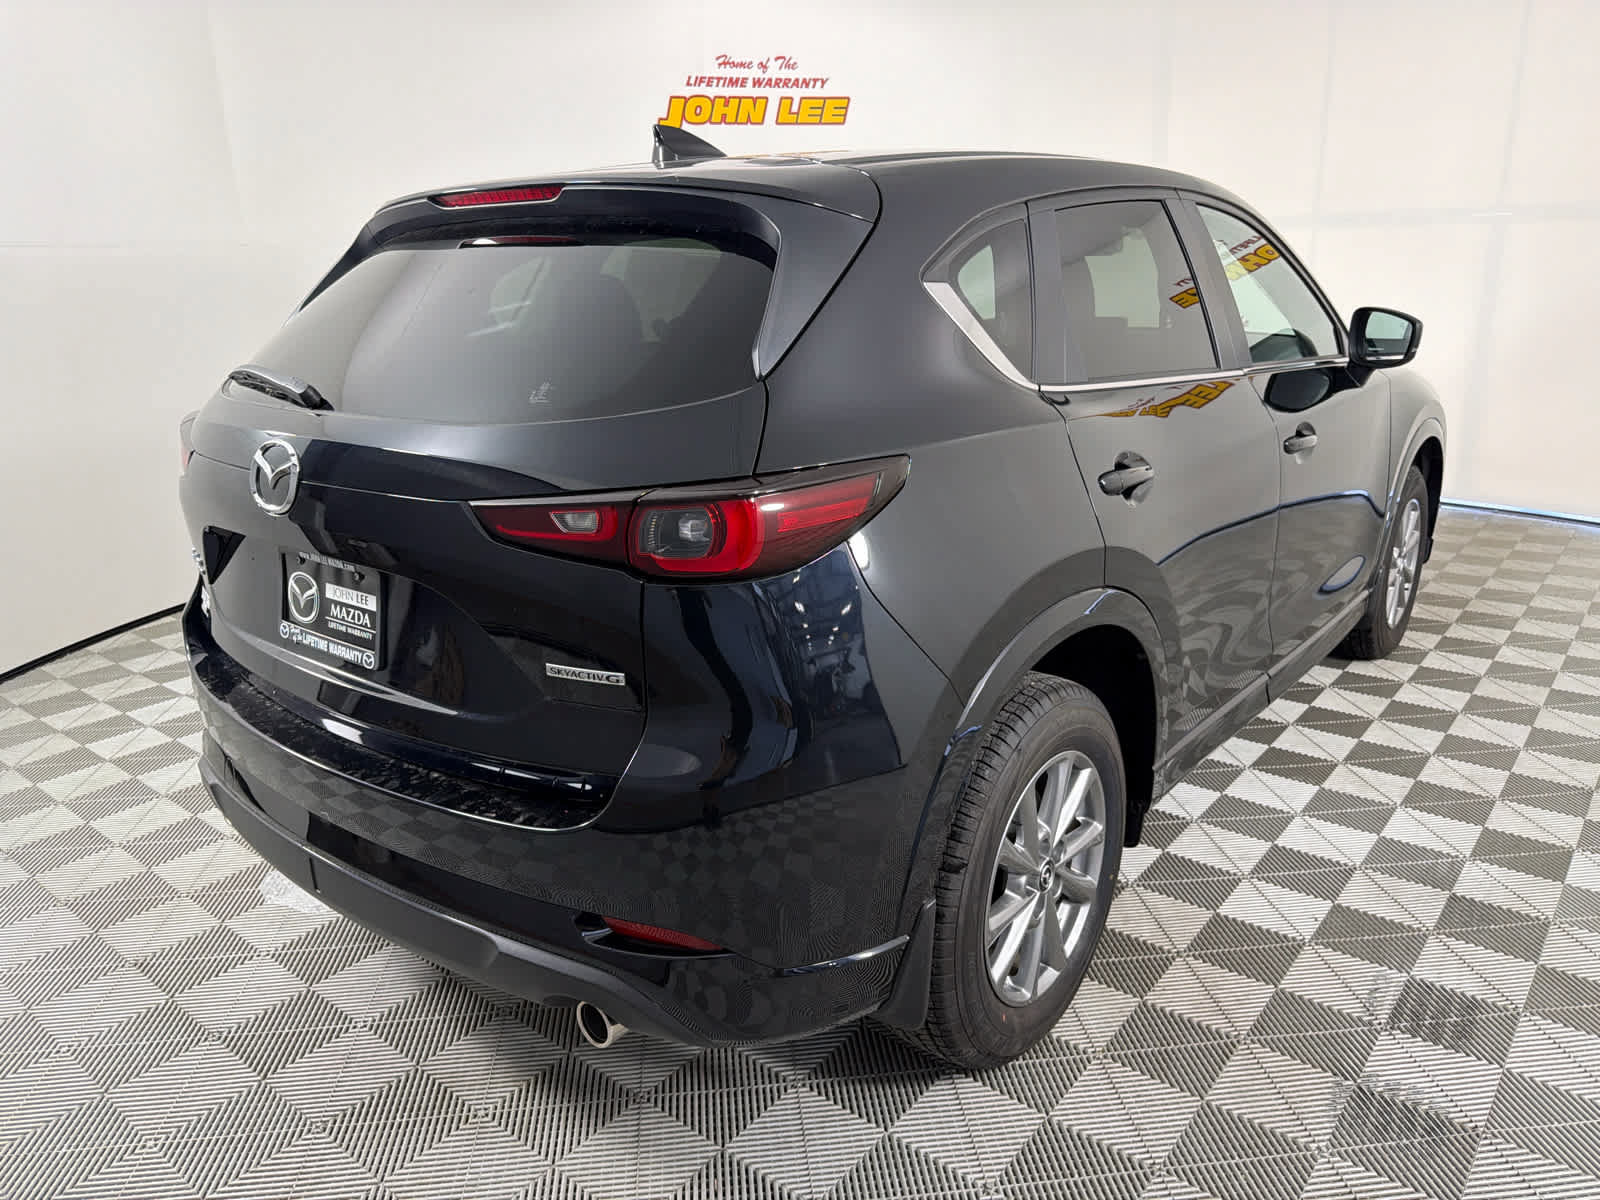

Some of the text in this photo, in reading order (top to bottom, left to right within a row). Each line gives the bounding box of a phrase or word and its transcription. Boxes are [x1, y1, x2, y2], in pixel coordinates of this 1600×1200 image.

[715, 54, 799, 73] Home of The
[686, 76, 829, 89] LIFETIME WARRANTY
[658, 94, 850, 128] JOHN LEE
[331, 585, 369, 606] JOHN LEE
[330, 603, 371, 628] MAZDA
[328, 621, 372, 640] LIFETIME WARRANTY
[302, 632, 362, 664] LIFETIME WARRANTY
